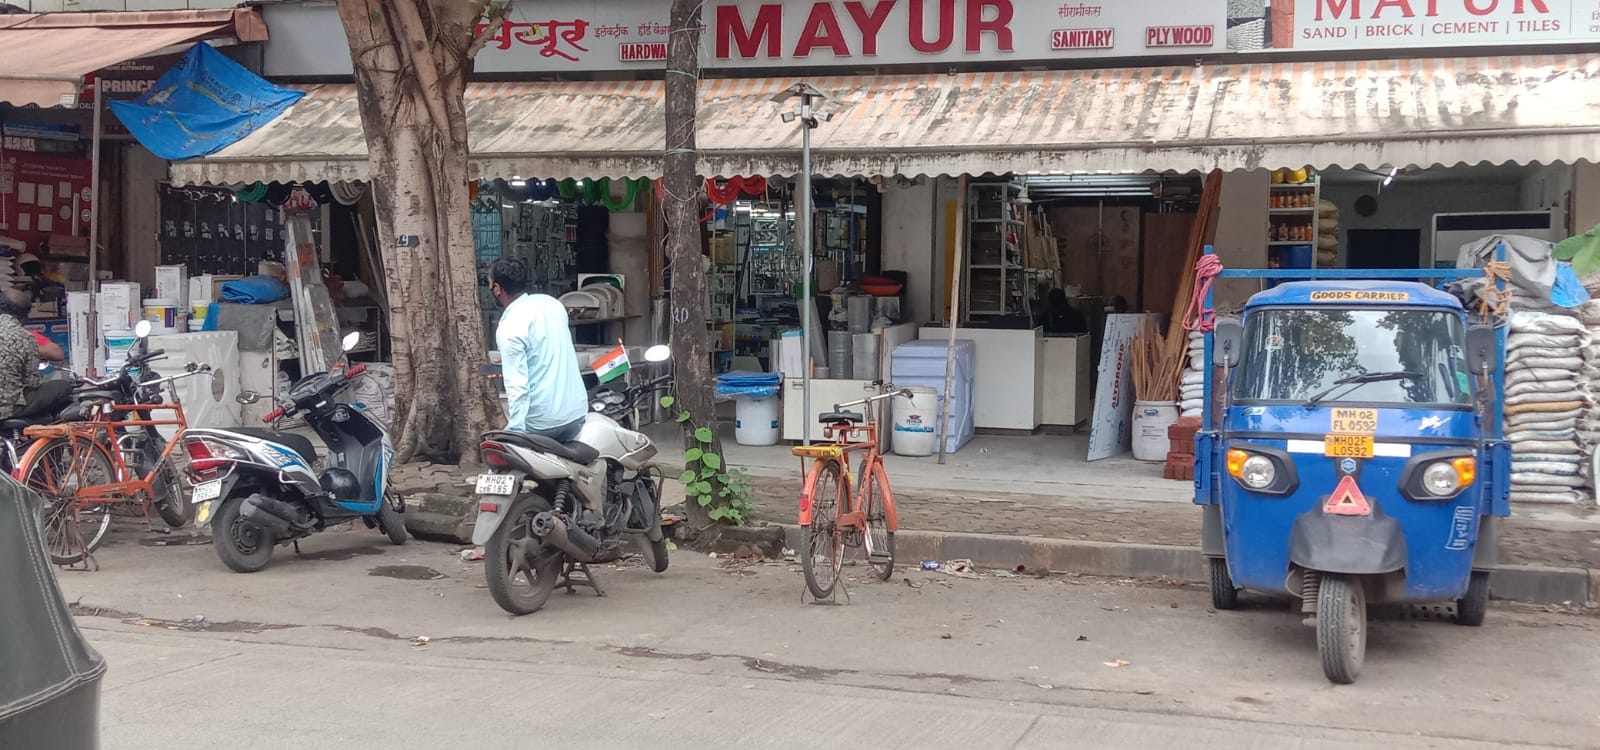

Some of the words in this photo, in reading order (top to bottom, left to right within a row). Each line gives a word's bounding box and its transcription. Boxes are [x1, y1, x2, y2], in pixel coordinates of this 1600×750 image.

[715, 0, 1015, 59] MAYUR
[1302, 26, 1347, 39] SAND
[1365, 24, 1413, 37] BRICK
[1432, 21, 1499, 34] CEMENT
[1517, 19, 1561, 32] TILES
[1053, 29, 1113, 47] SANITARY
[621, 43, 667, 60] HARDWA
[1311, 291, 1352, 301] GOODS
[1355, 291, 1406, 300] CARRIER
[1336, 410, 1356, 419] MH
[1359, 410, 1374, 420] 02
[1333, 420, 1346, 430] FL
[1348, 420, 1376, 431] 0592
[1333, 436, 1367, 446] MH02F
[1333, 447, 1368, 457] L0592
[485, 475, 506, 485] MH02
